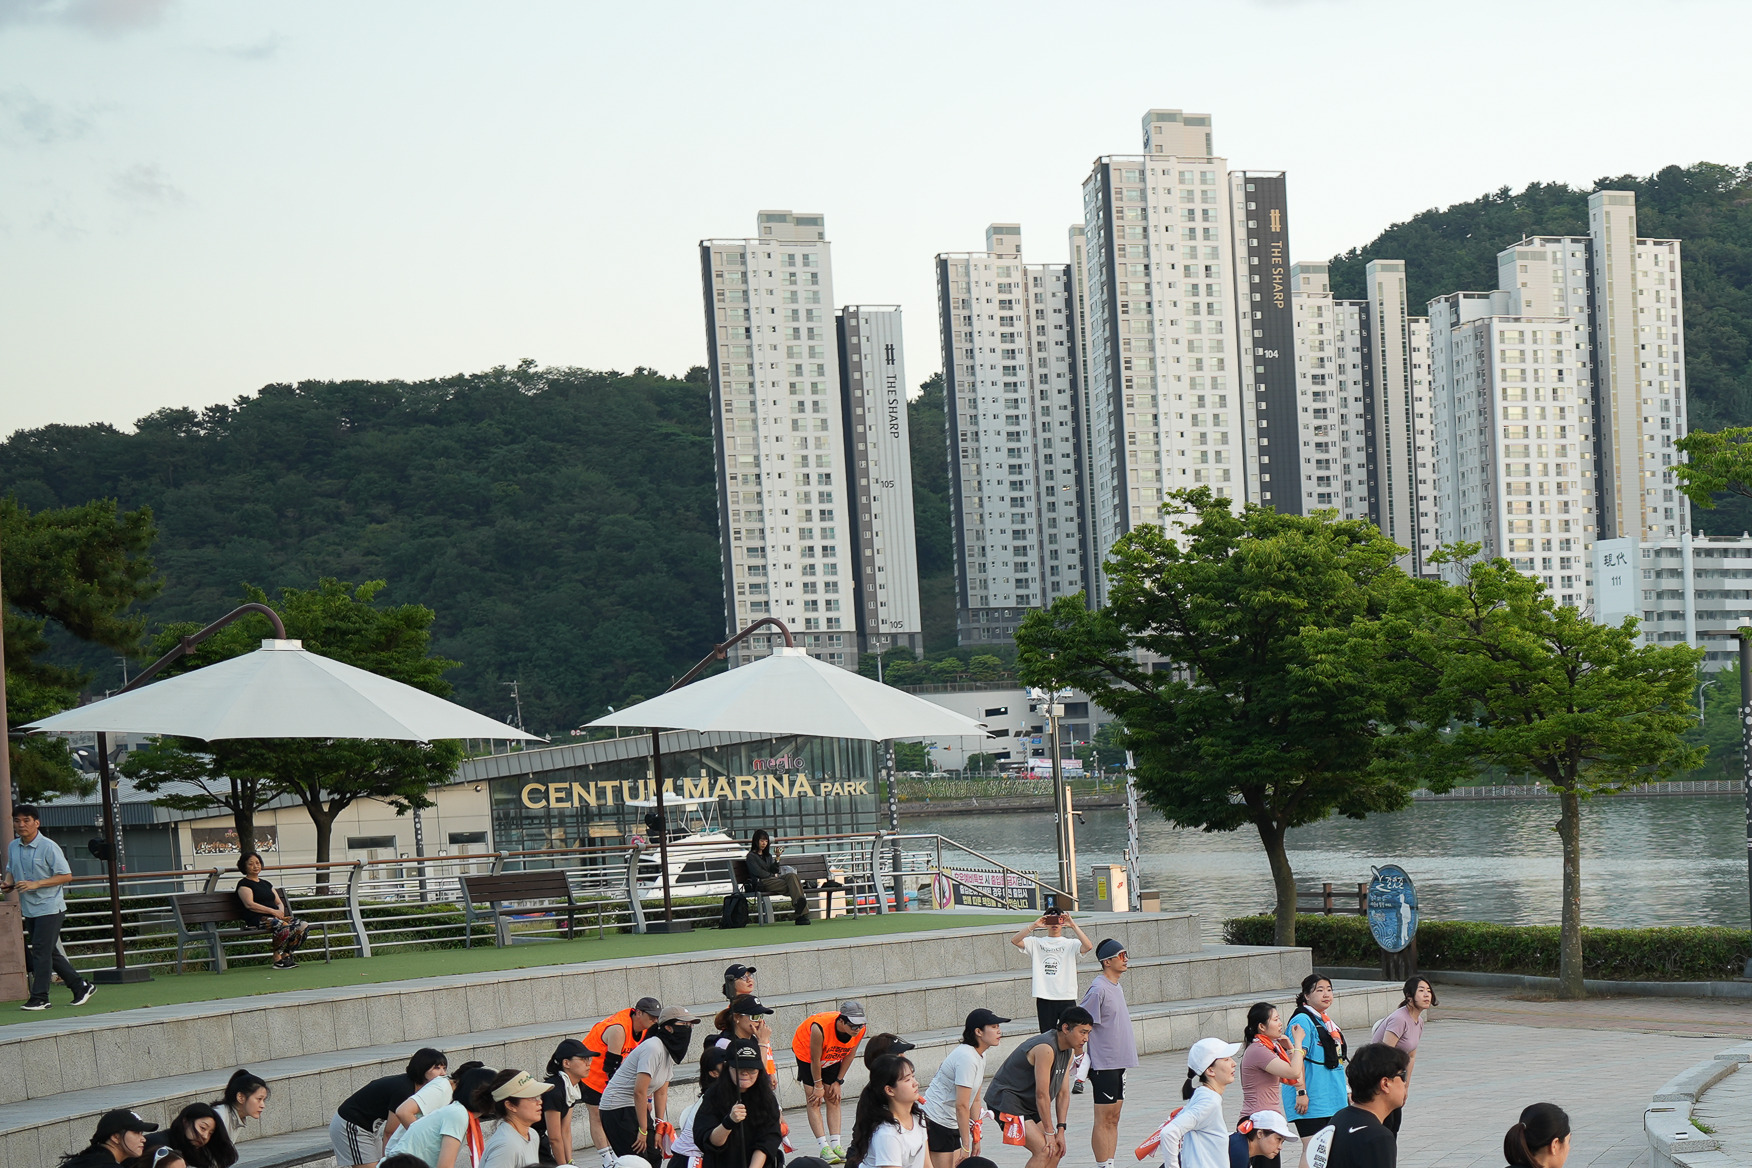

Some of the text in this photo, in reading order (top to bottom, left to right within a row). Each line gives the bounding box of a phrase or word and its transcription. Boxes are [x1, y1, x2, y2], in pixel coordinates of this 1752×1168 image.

[1271, 241, 1285, 309] THE SHARP
[1264, 350, 1279, 359] 104
[886, 374, 900, 439] THE SHARP
[880, 480, 894, 489] 105
[889, 620, 903, 629] 105
[753, 754, 806, 774] meglio
[683, 772, 816, 801] MARINA
[820, 780, 869, 797] PARK
